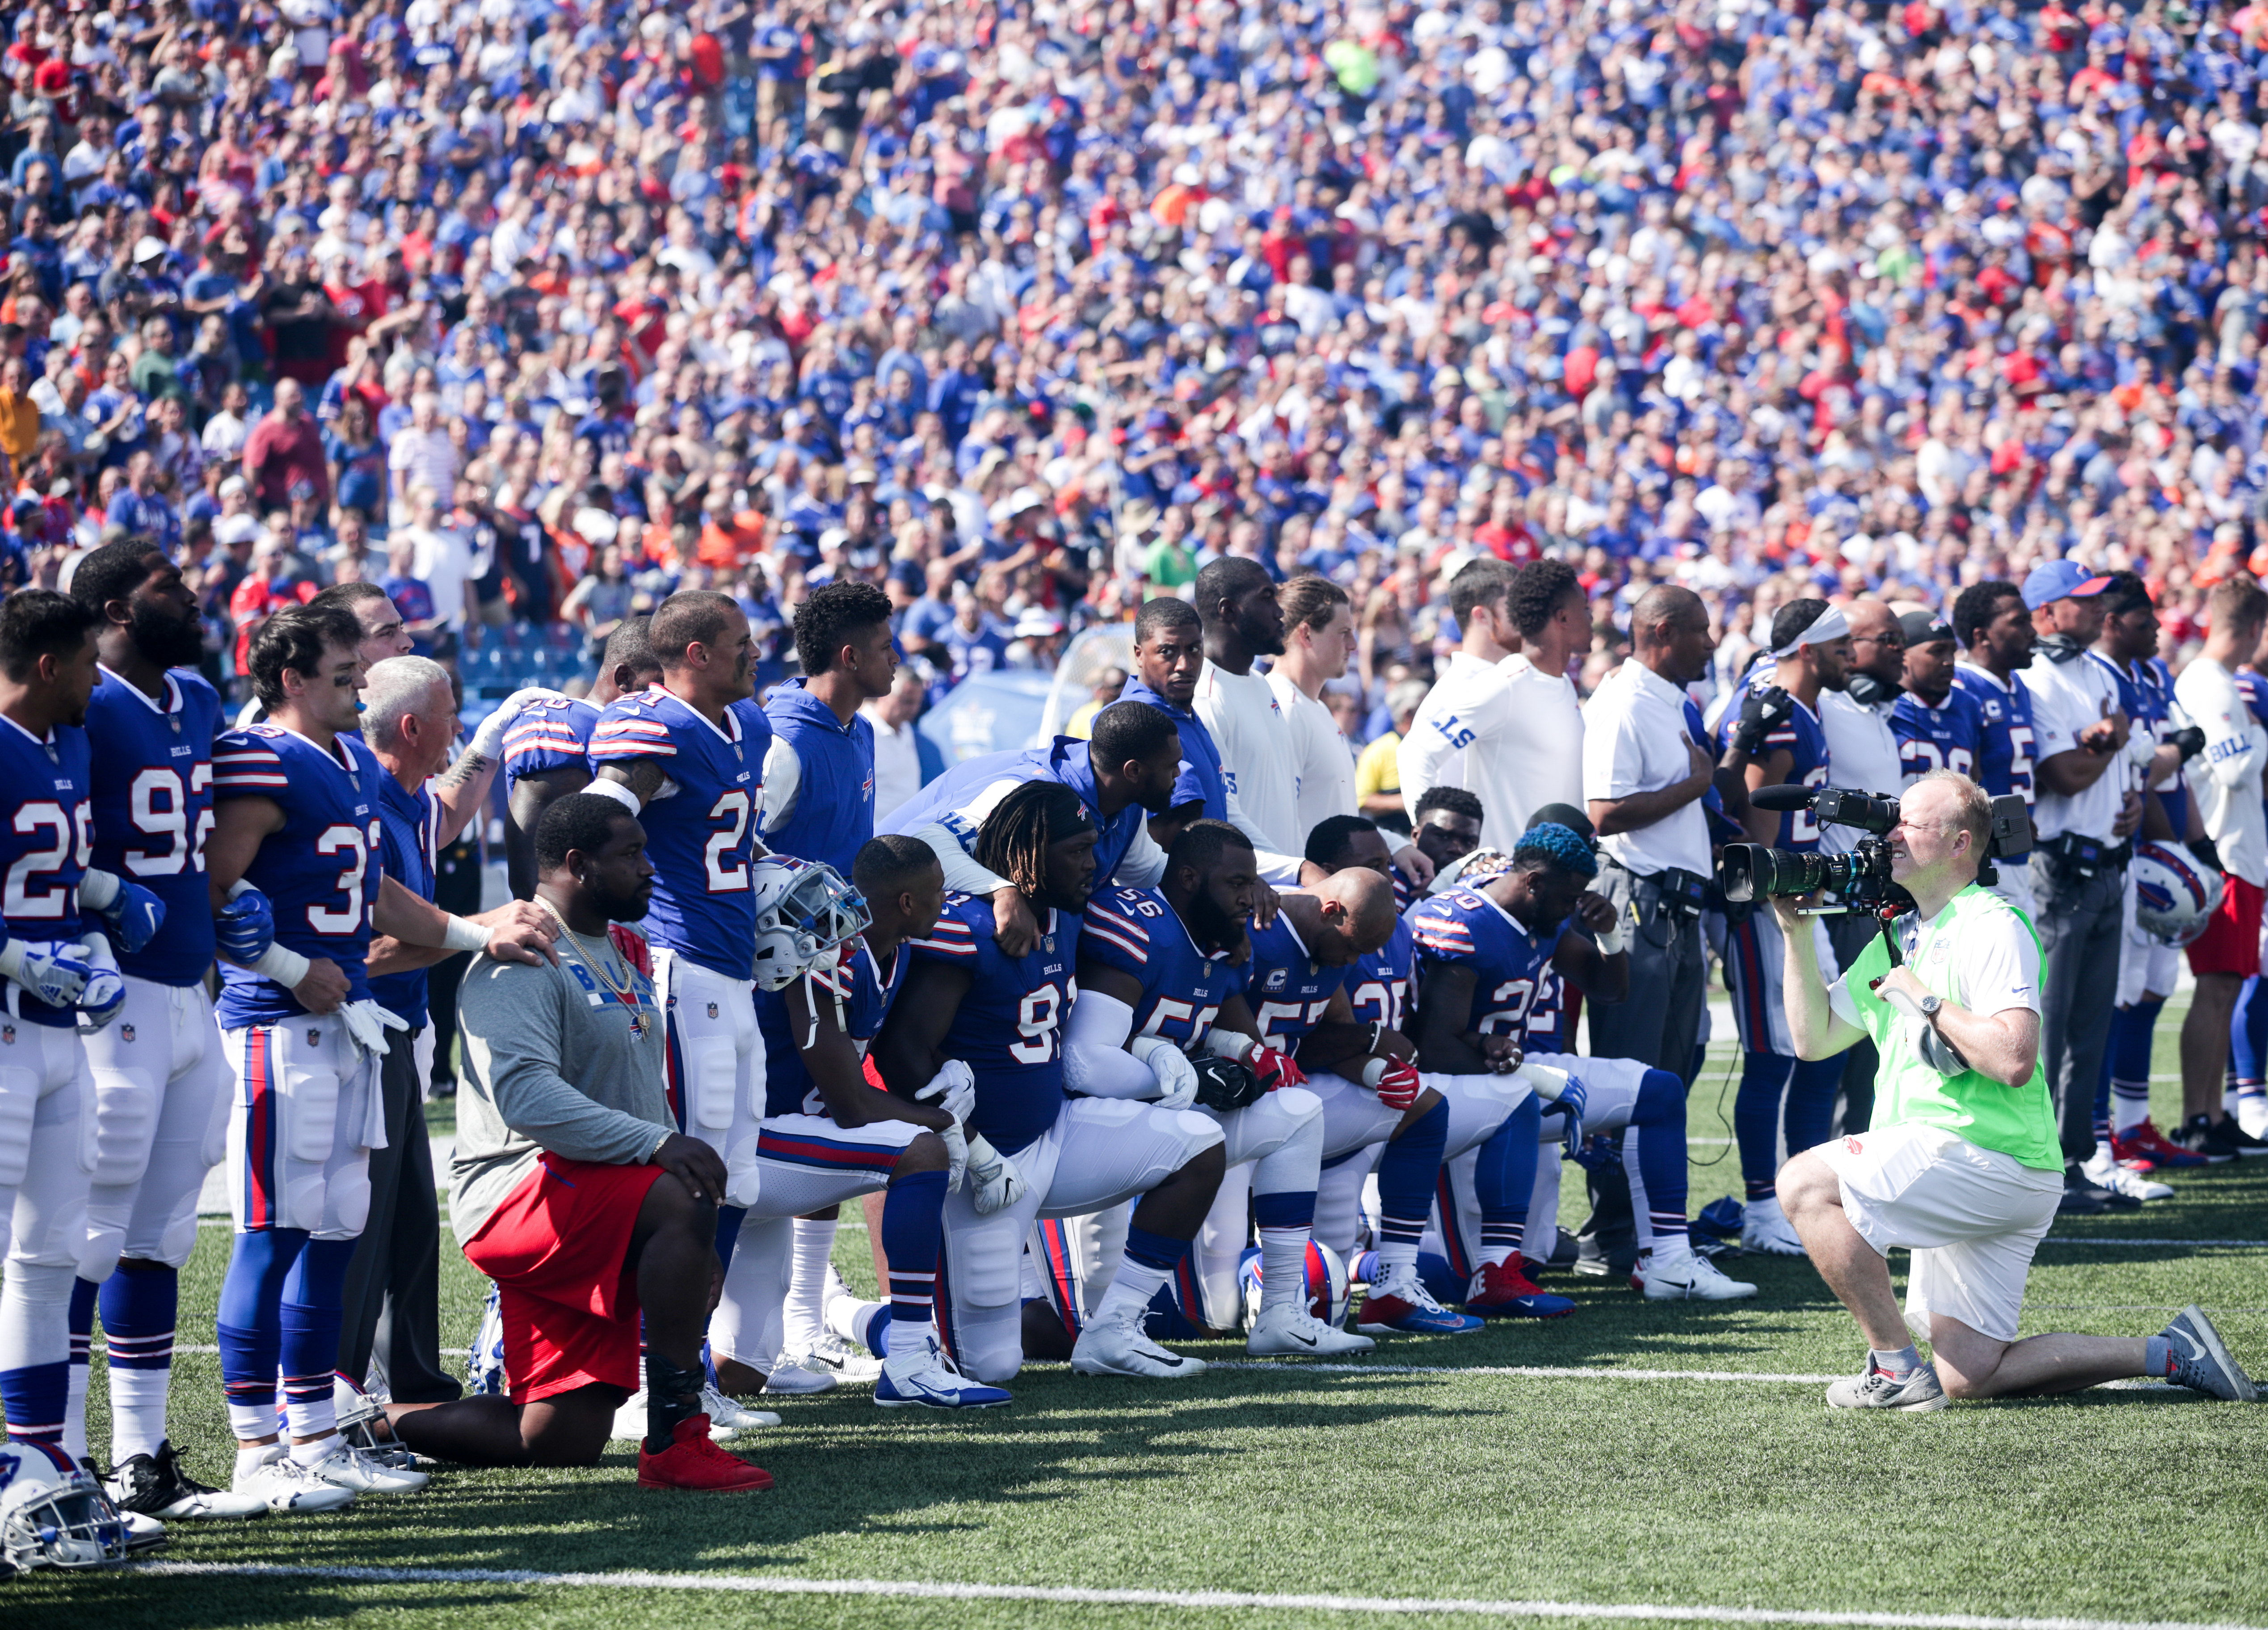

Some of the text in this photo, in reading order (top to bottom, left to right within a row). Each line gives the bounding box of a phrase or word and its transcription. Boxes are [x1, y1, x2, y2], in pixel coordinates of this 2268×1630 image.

[614, 691, 664, 707] 21
[1985, 699, 2002, 716] C
[170, 746, 192, 757] BILLS
[736, 771, 750, 783] BILLS
[54, 779, 73, 790] BILLS
[355, 805, 369, 816] BILLS
[305, 817, 383, 936] 3
[944, 890, 972, 907] 1
[1116, 888, 1164, 918] 56
[1434, 889, 1483, 910] 20
[1932, 948, 1946, 962] NFL
[1044, 963, 1062, 975] BILLS
[1377, 967, 1393, 976] BILLS
[1267, 969, 1286, 987] C
[1193, 987, 1208, 997] BILLS
[1301, 985, 1318, 994] BILLS
